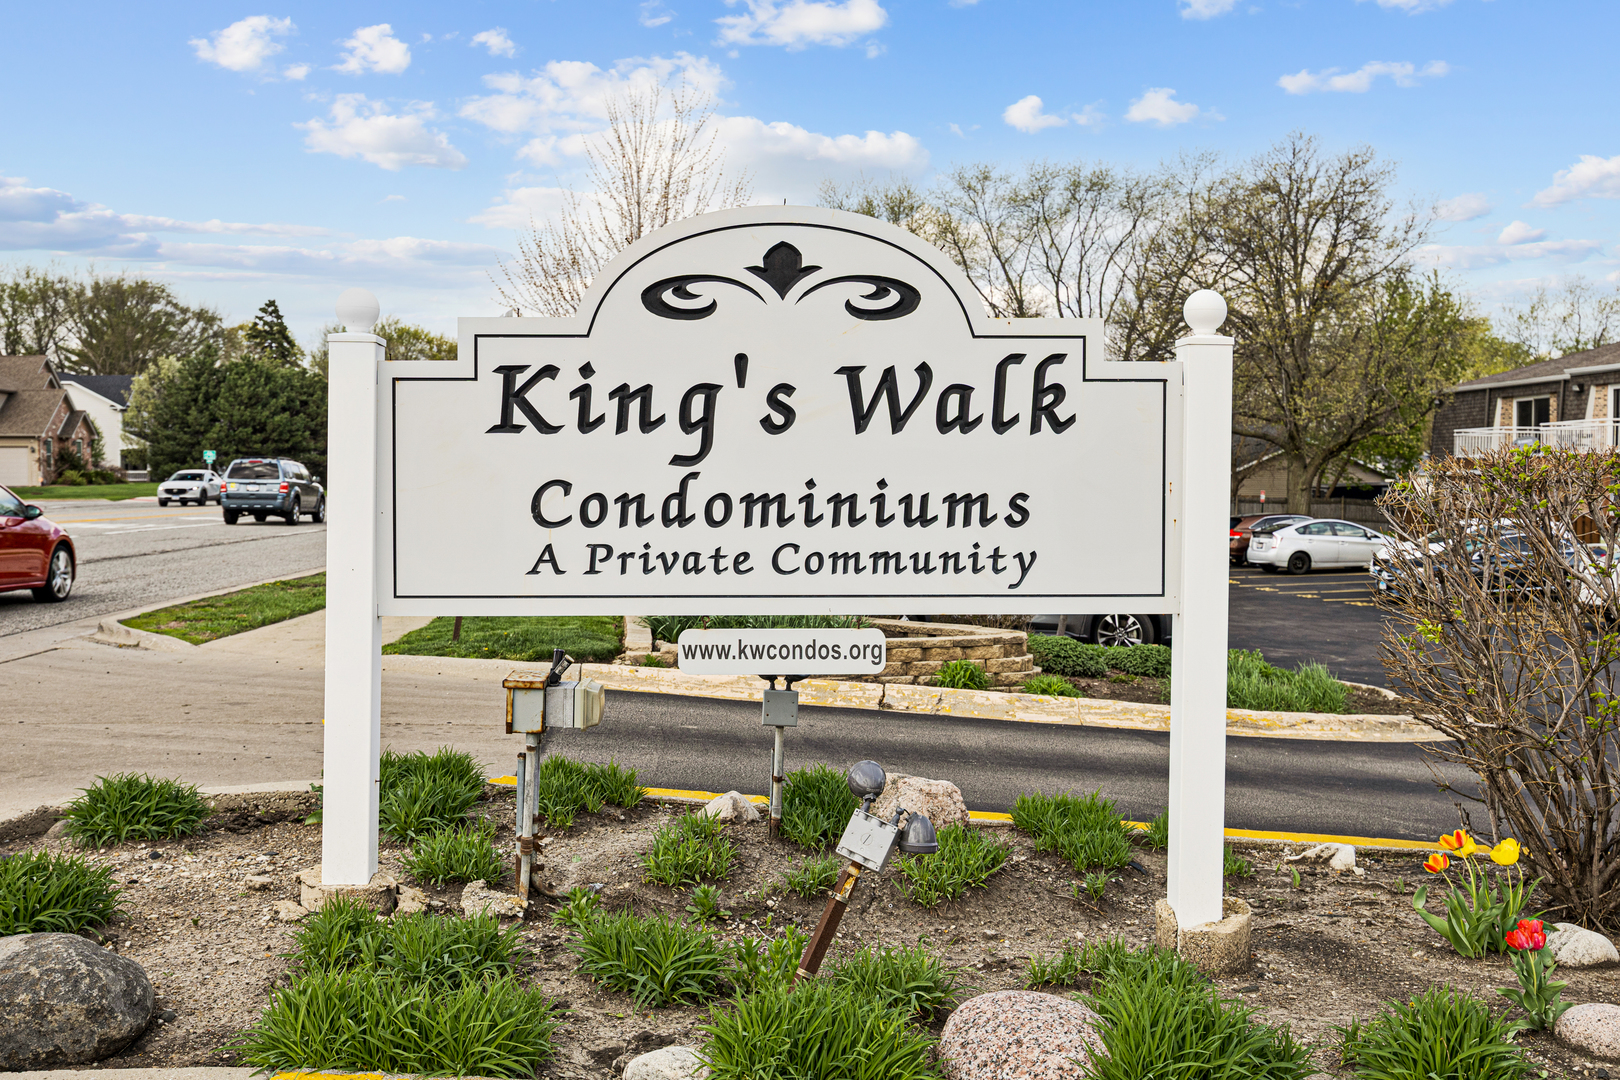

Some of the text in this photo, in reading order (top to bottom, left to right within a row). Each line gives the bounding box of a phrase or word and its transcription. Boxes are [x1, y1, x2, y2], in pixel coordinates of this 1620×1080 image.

[485, 353, 1077, 466] King's Walk
[531, 472, 1030, 529] Condominiums
[526, 542, 1038, 590] A Private Community
[681, 638, 883, 666] www.kwcondos.org
